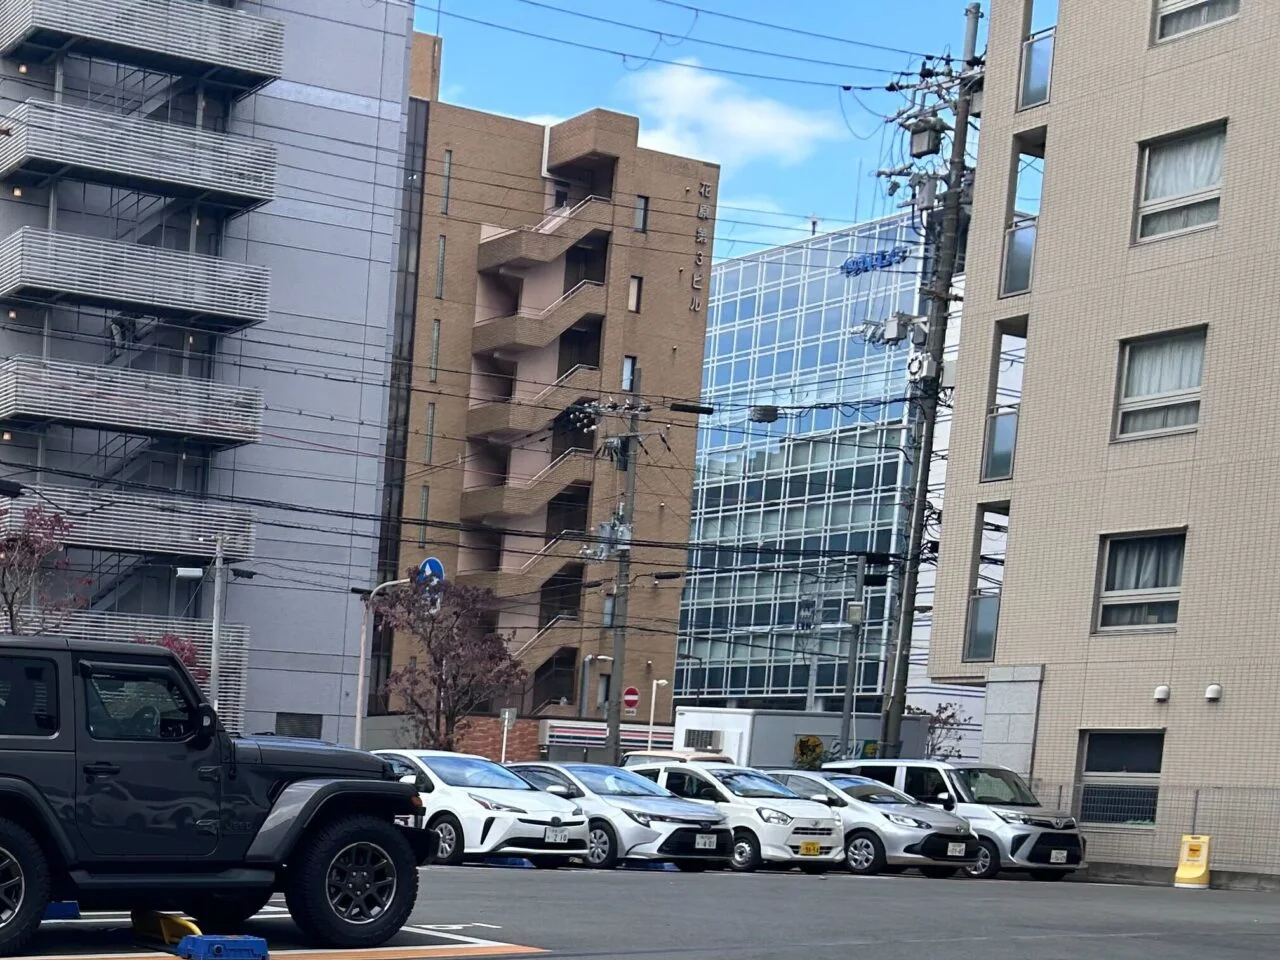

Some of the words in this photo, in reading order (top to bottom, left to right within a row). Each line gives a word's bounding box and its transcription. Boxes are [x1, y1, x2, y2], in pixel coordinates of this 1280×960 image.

[689, 182, 712, 312] 花原第3ビル
